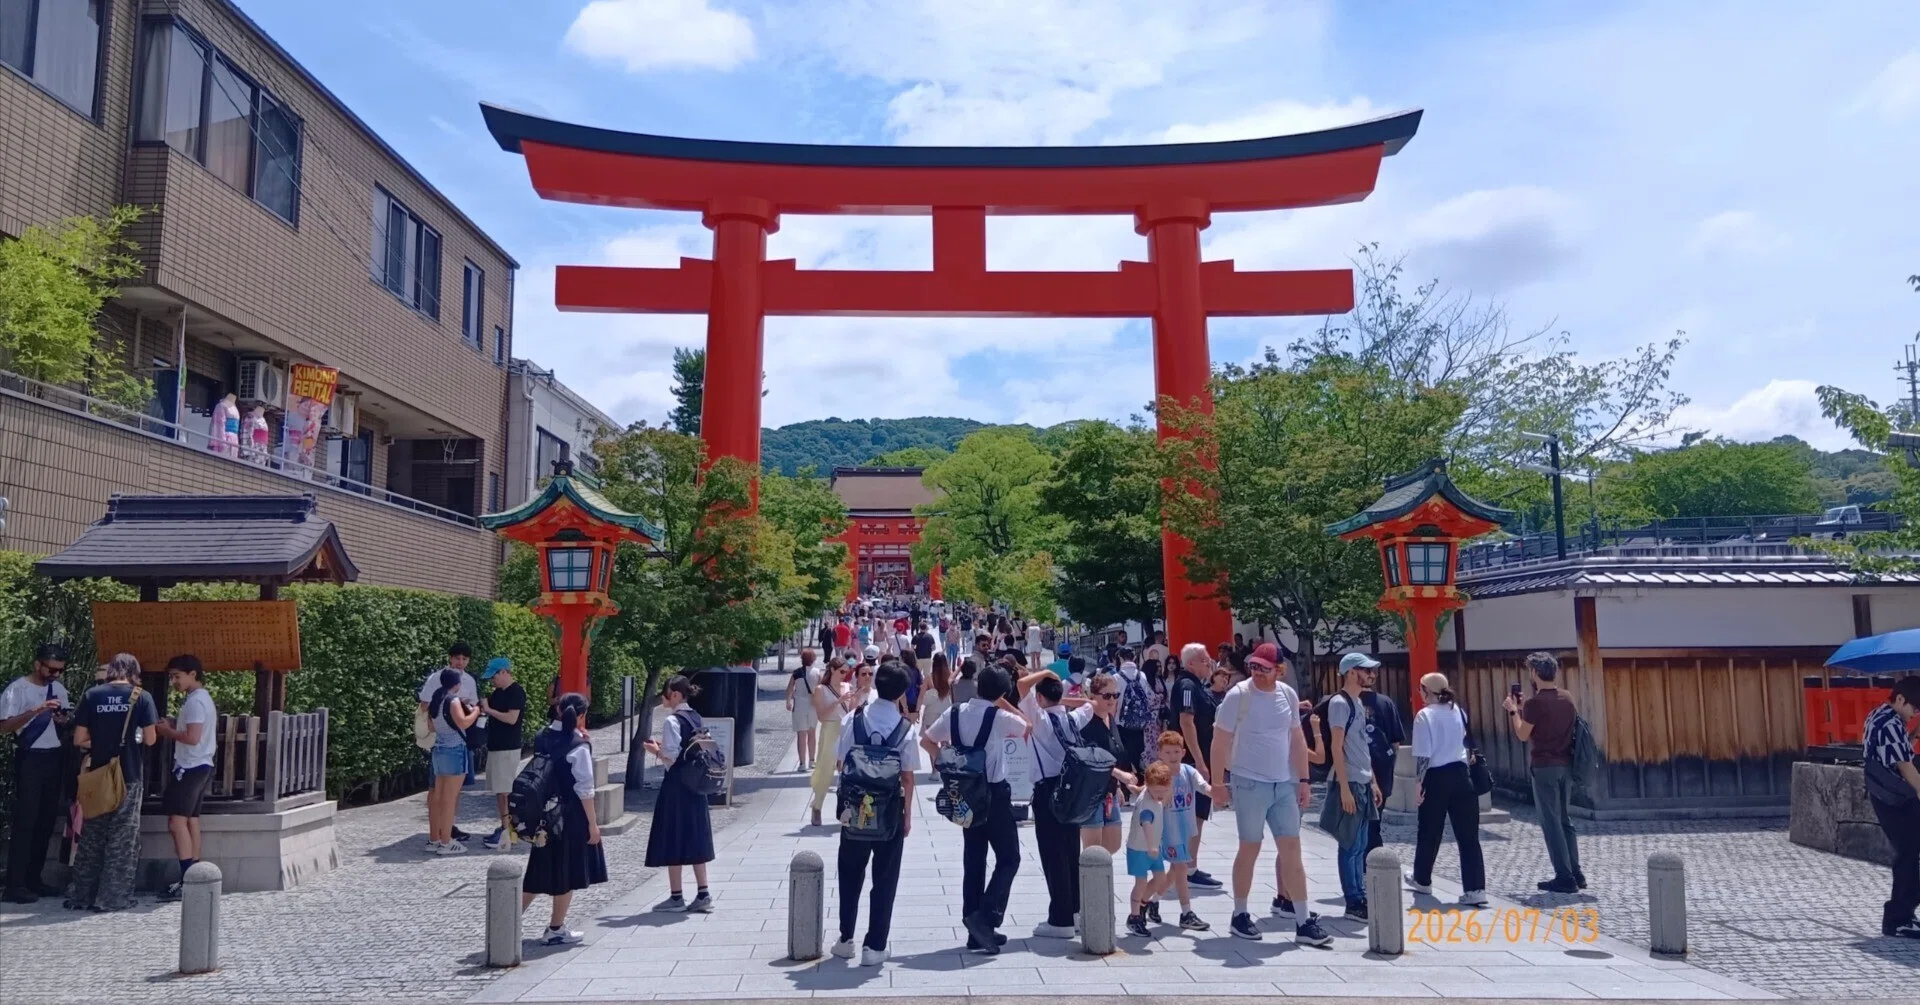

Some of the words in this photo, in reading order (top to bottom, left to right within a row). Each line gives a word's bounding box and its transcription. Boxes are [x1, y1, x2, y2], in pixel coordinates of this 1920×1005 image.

[295, 365, 337, 384] KIMONO
[294, 380, 333, 404] RENTAL
[108, 696, 123, 704] THE
